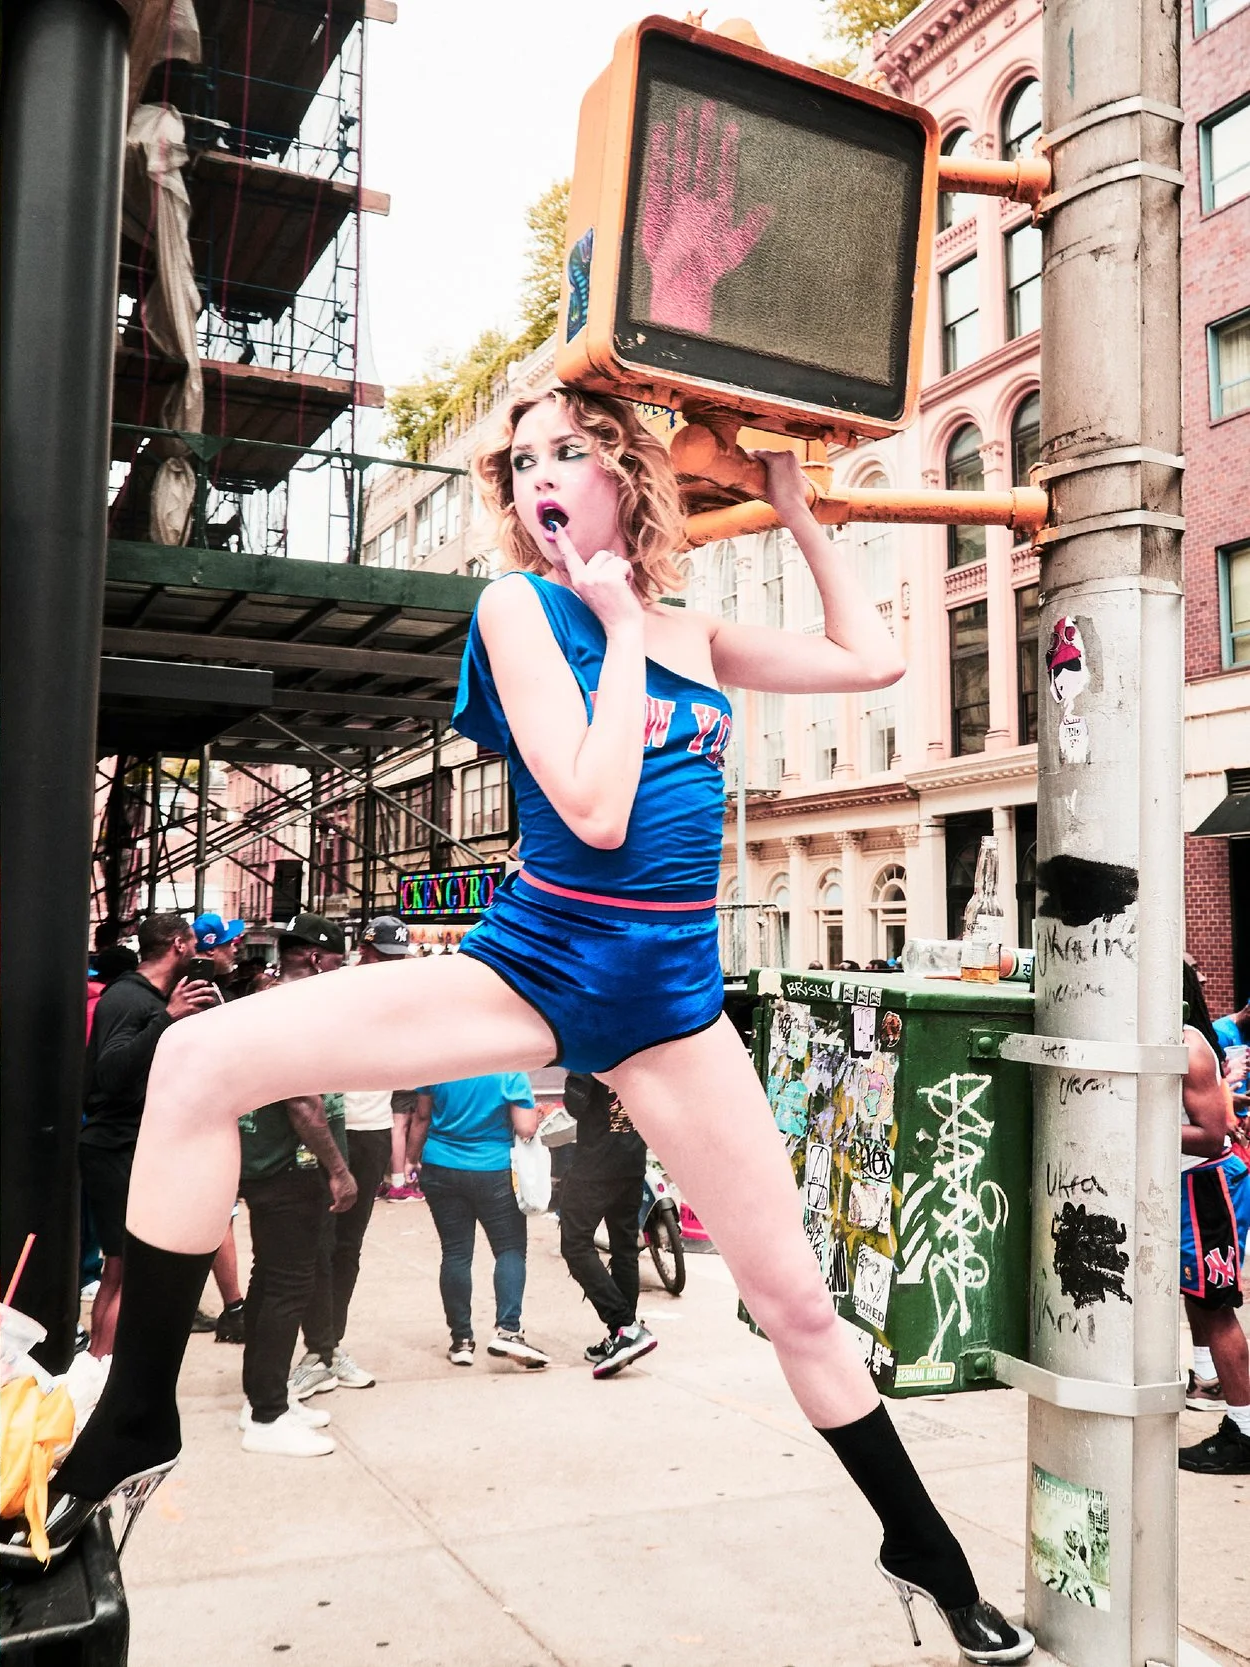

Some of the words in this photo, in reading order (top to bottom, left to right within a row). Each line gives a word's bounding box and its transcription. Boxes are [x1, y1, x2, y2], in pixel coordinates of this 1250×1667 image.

[445, 875, 494, 908] GYRO
[1204, 1245, 1235, 1289] NY
[853, 1295, 885, 1323] BORED
